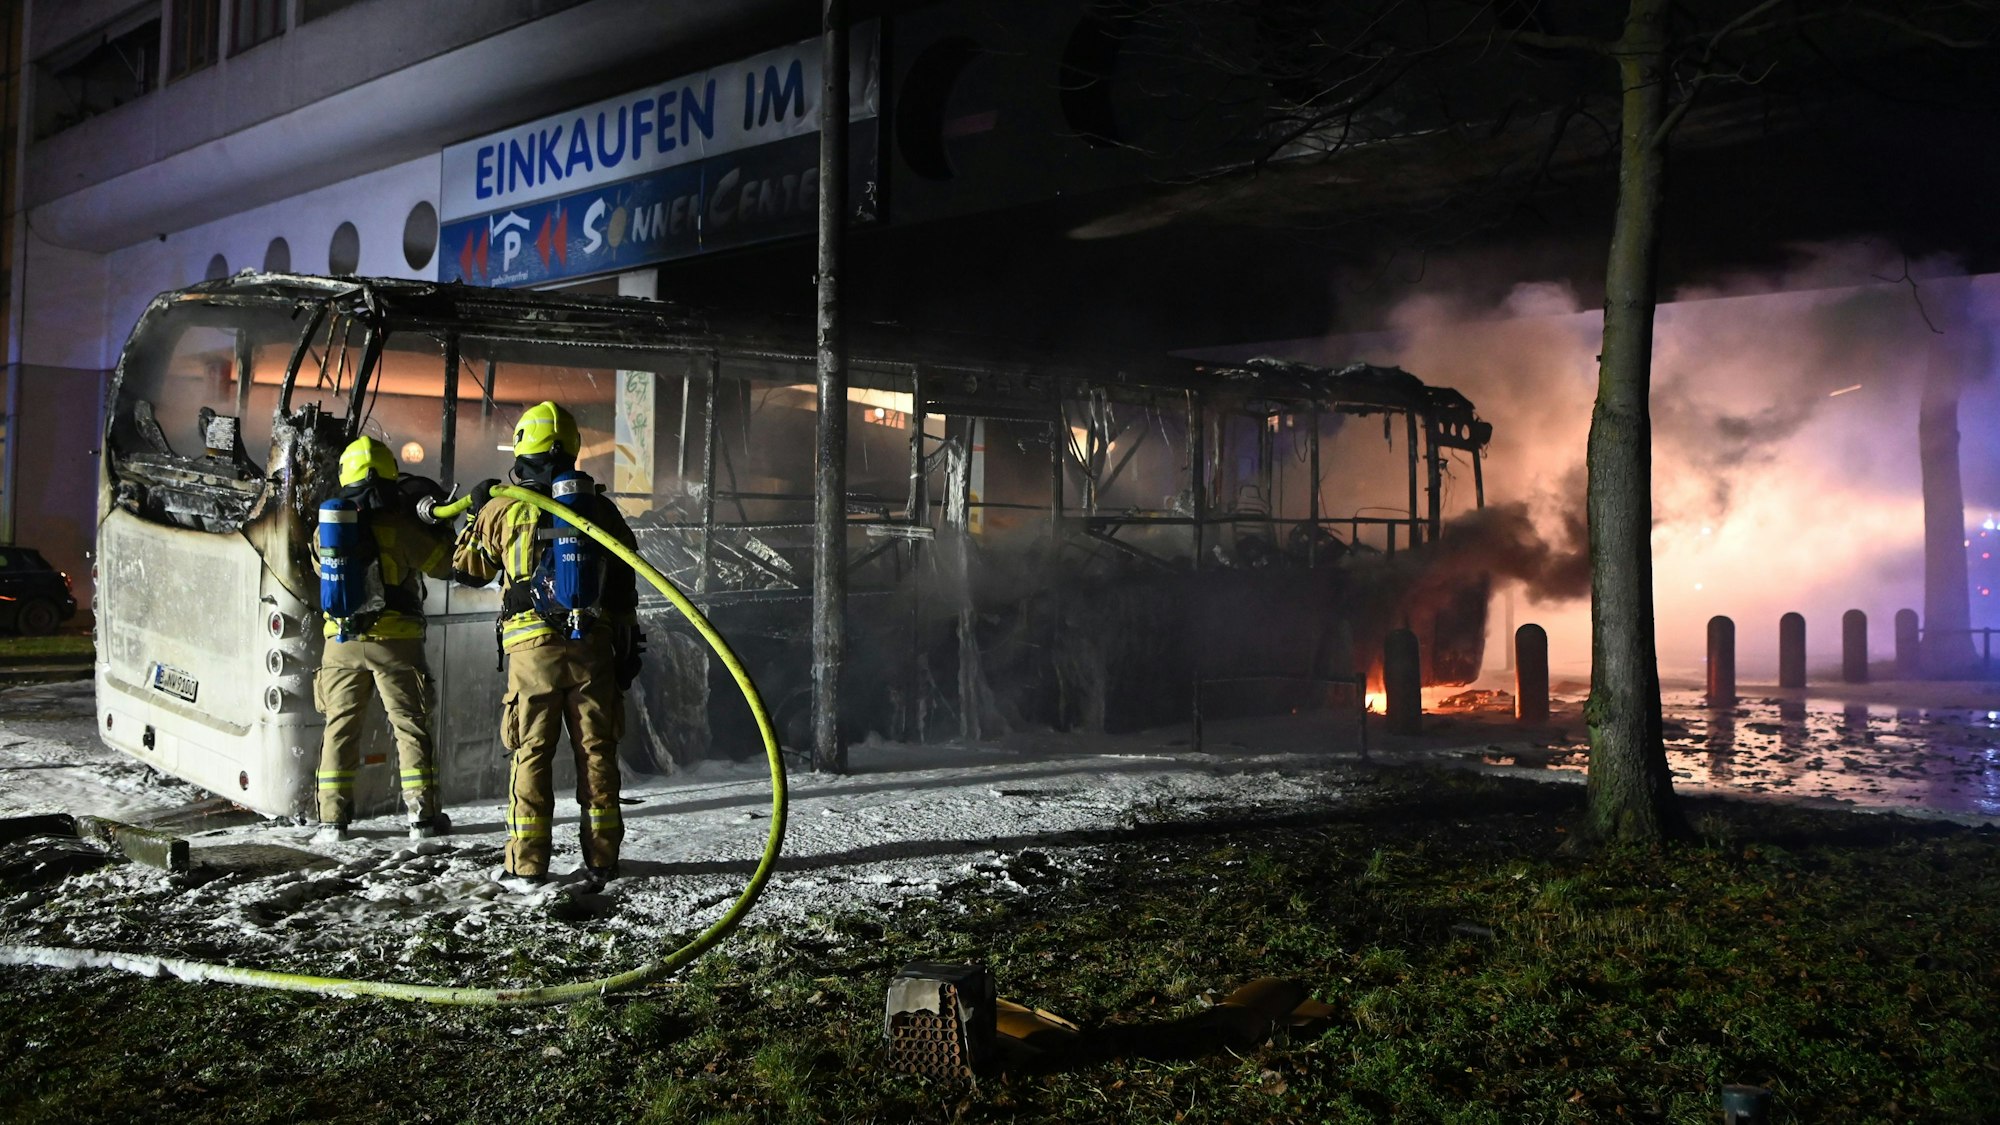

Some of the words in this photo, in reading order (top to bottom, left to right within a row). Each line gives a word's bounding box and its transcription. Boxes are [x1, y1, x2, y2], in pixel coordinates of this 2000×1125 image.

[476, 78, 715, 201] EINKAUFEN
[743, 58, 805, 131] IM
[503, 231, 522, 272] P
[562, 553, 576, 563] 300
[330, 573, 345, 582] BAR
